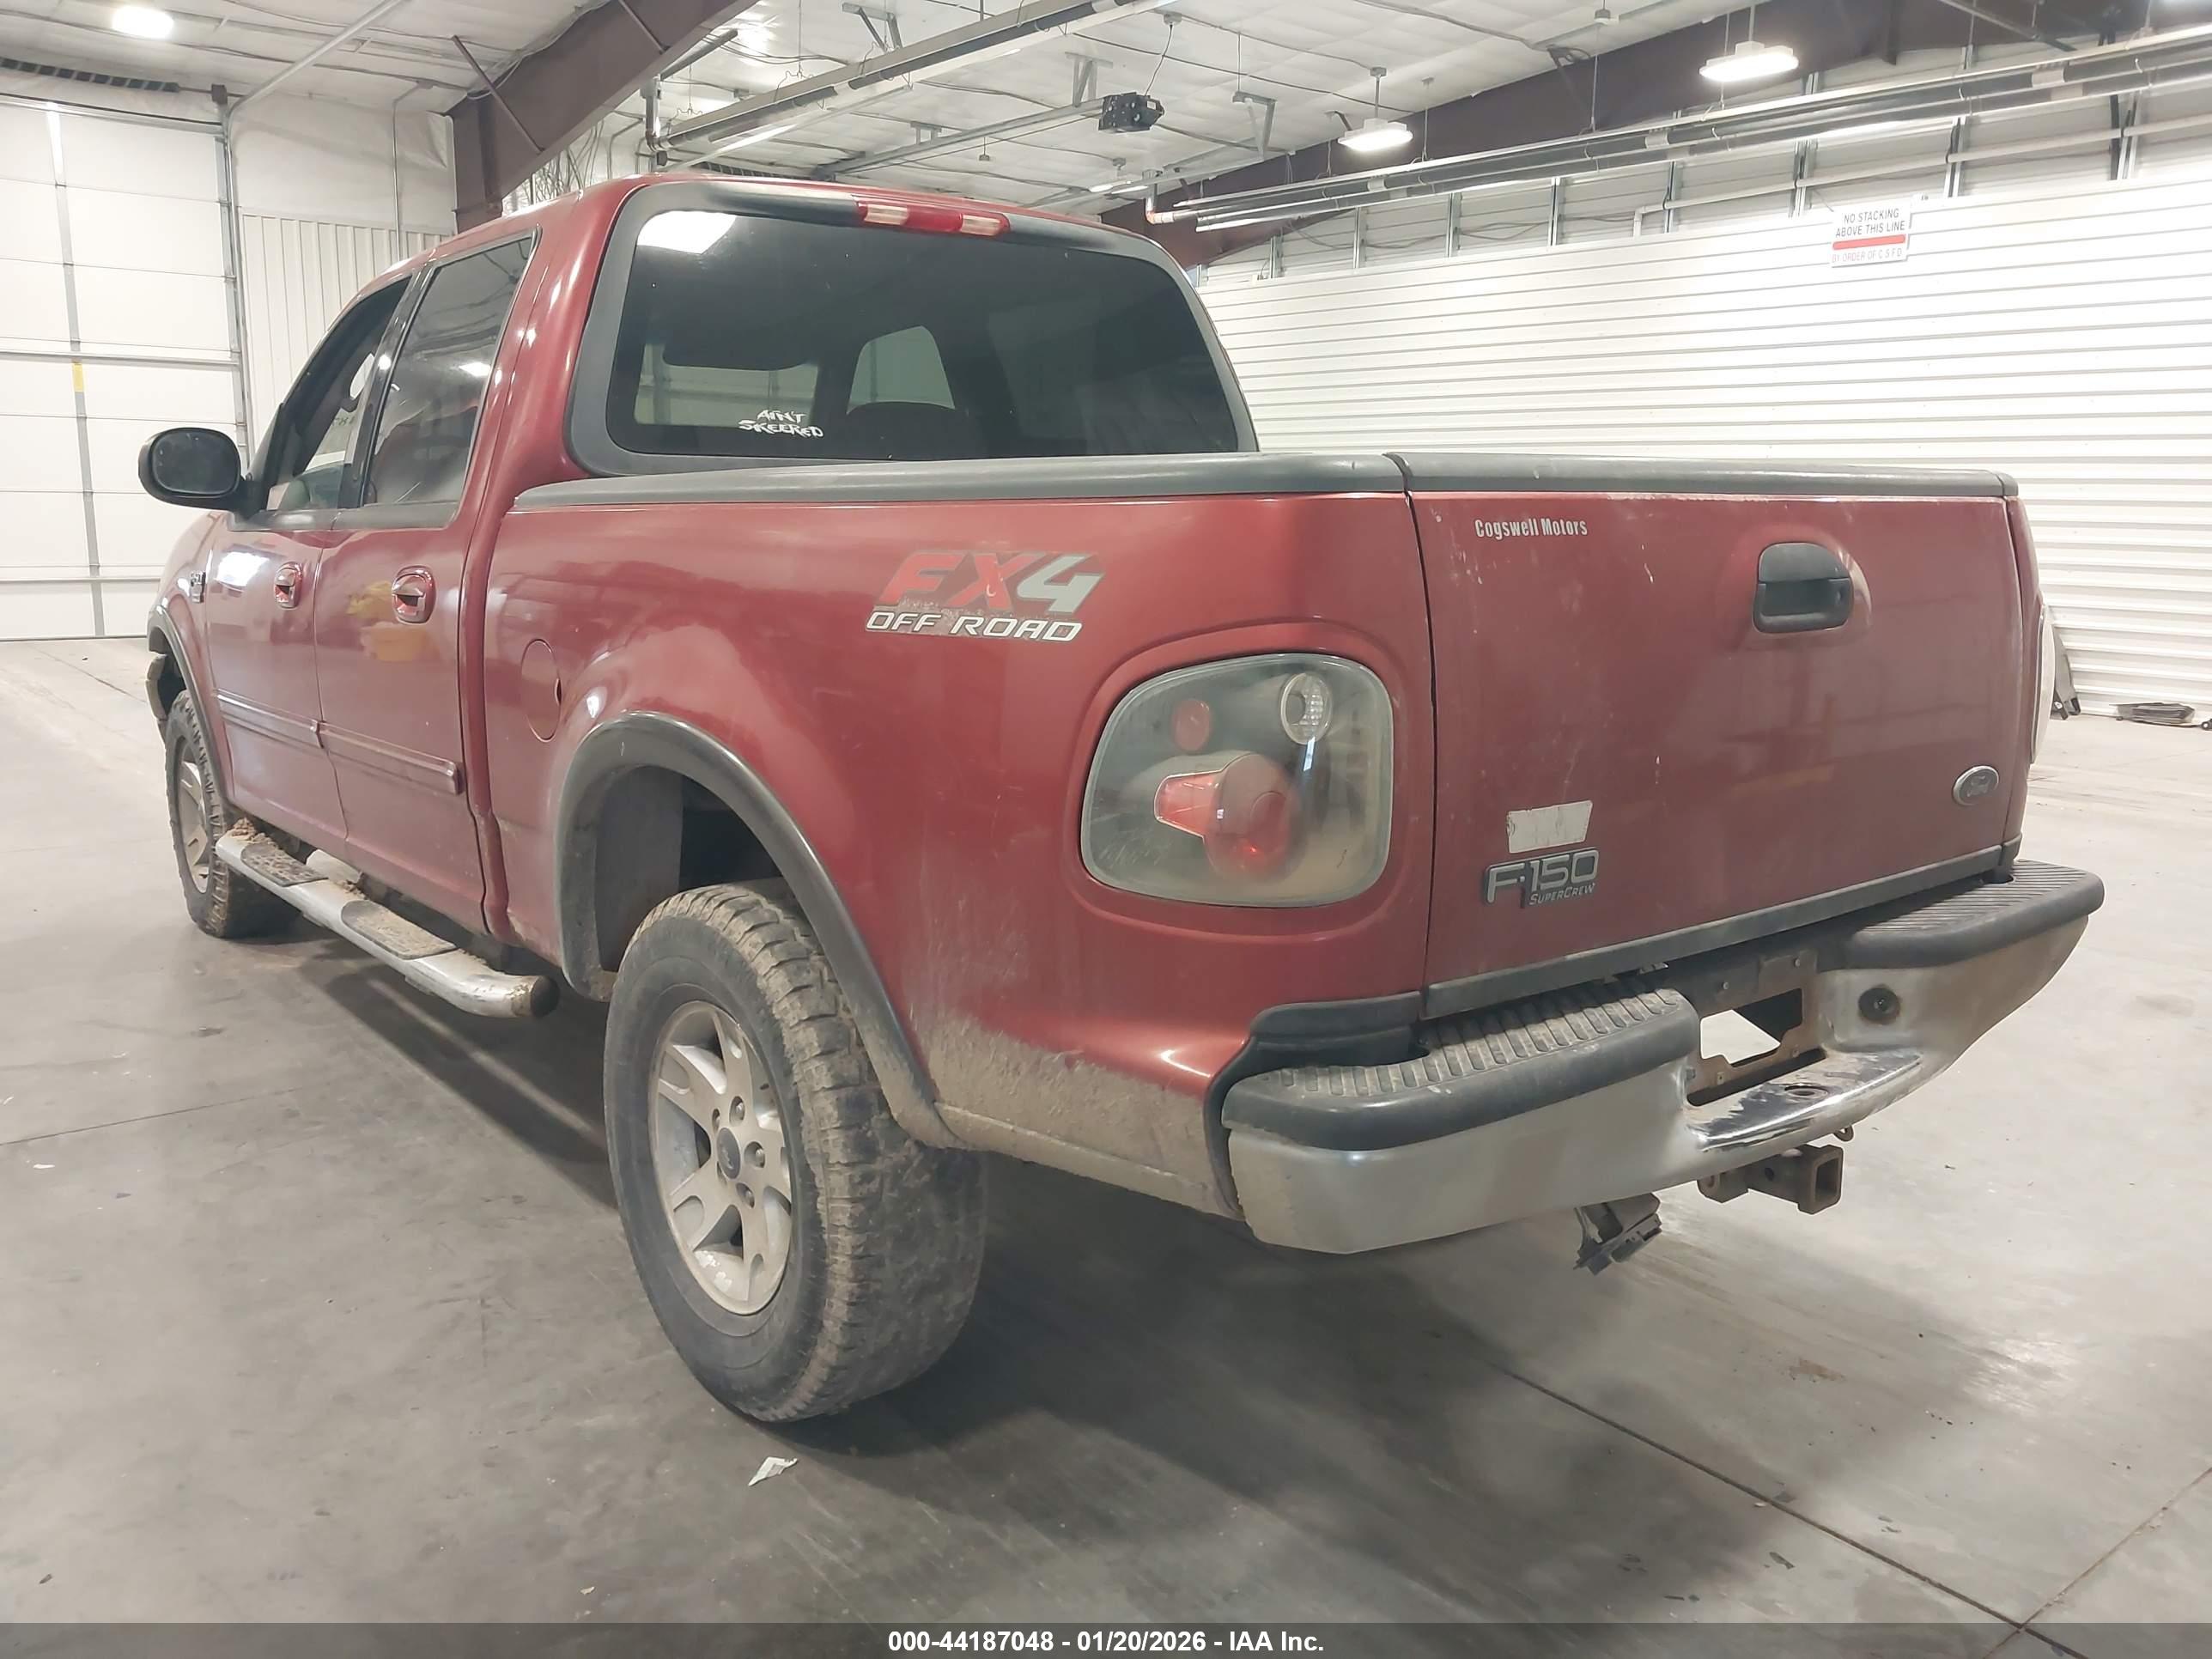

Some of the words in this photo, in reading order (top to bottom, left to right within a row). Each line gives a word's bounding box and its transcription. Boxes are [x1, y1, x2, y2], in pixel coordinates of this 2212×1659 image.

[1844, 213, 1856, 224] NO
[1857, 208, 1899, 222] STACKING
[1835, 225, 1863, 238] ABOVE
[1865, 222, 1884, 234] THIS
[1887, 220, 1905, 233] LINE
[1832, 253, 1840, 263] BY
[1843, 251, 1866, 263] ORDER
[1868, 249, 1877, 260] OF
[738, 420, 823, 437] SKEERED
[1475, 519, 1540, 540] Cogswell
[1540, 518, 1588, 536] Motors
[878, 550, 1106, 614] FX4
[866, 611, 942, 631] OFF
[950, 617, 1083, 642] ROAD
